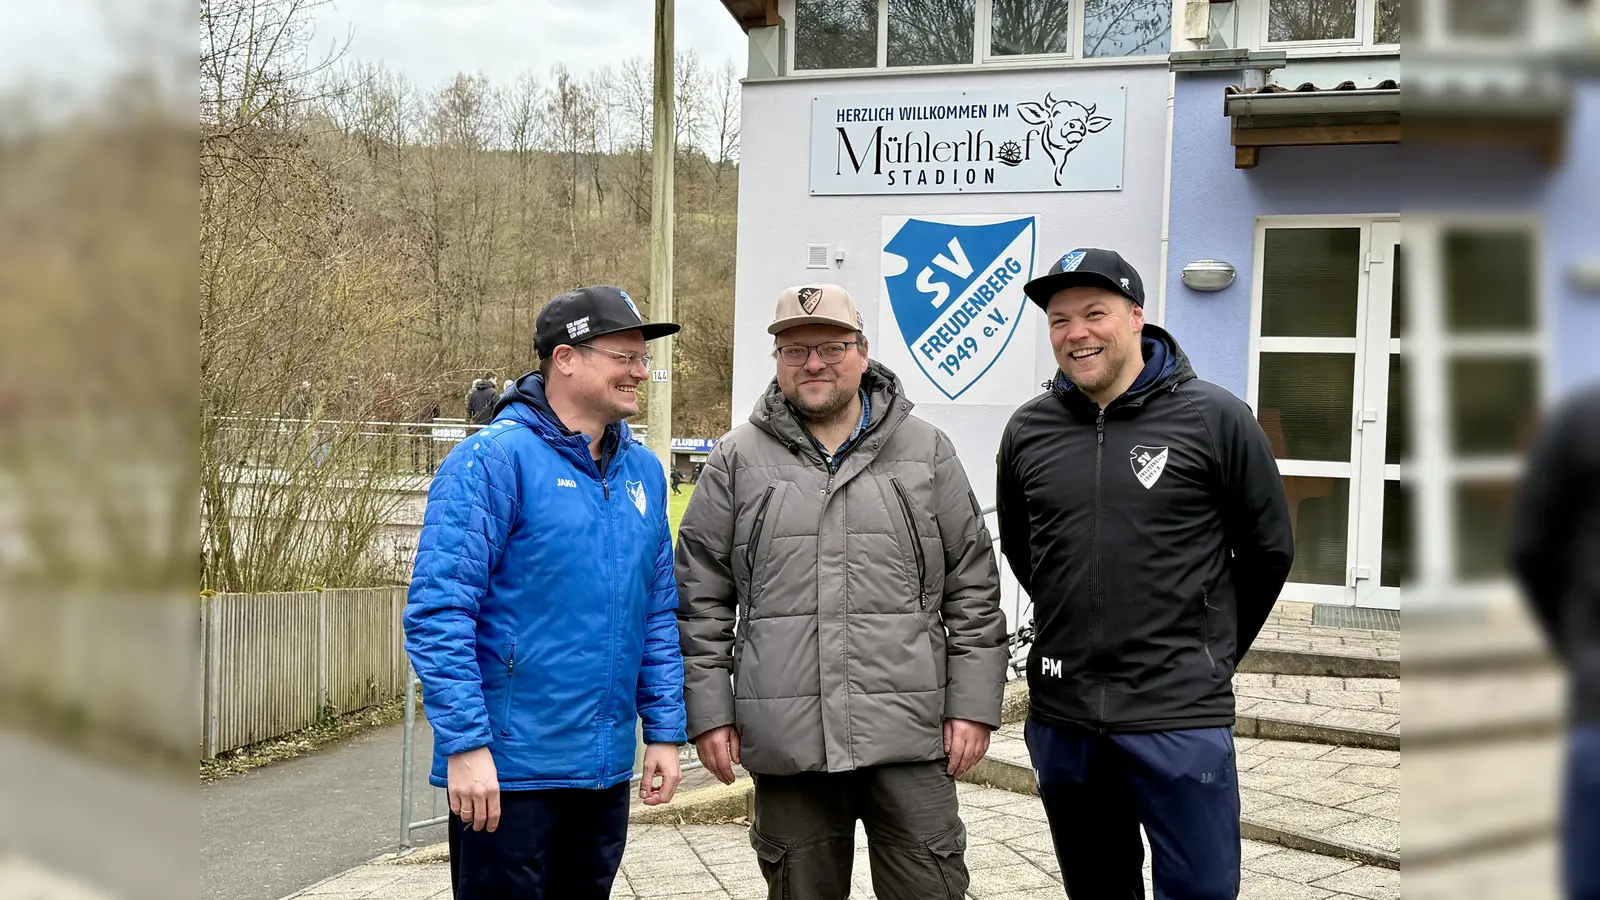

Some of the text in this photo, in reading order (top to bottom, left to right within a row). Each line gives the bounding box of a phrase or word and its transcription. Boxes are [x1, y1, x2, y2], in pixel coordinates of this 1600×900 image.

[836, 103, 1009, 123] HERZLICH WILLKOMMEN IM
[835, 126, 1040, 175] Mühlerlhof
[887, 168, 995, 186] STADION
[916, 236, 974, 309] SV
[919, 257, 1022, 361] FREUDENBERG
[937, 307, 1009, 377] 1949 e.V.
[653, 371, 667, 381] 144
[1137, 451, 1152, 467] SV
[557, 478, 577, 488] JAKO
[1041, 656, 1062, 679] PM
